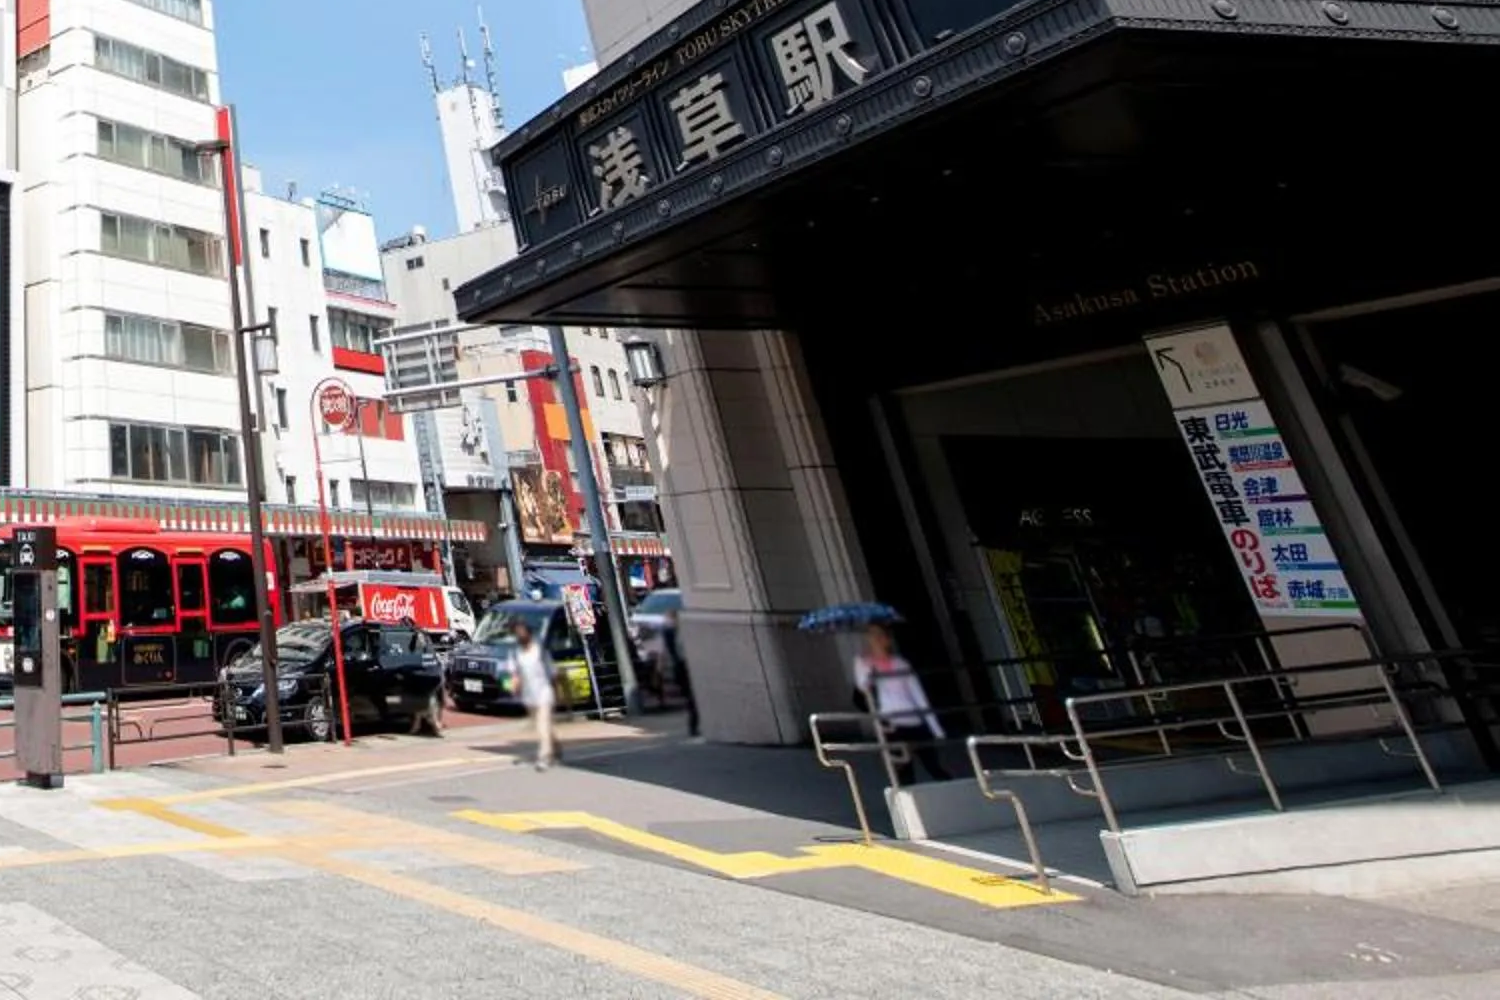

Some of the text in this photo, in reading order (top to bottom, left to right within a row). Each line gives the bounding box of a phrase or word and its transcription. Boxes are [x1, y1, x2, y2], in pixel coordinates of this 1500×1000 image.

[676, 28, 717, 65] TOBU
[589, 0, 870, 216] 浅草駅
[1032, 259, 1261, 328] Asakusa Station
[1215, 411, 1249, 431] 日光
[1243, 476, 1279, 497] 会津
[1180, 416, 1281, 599] 東武電車のりば
[1257, 508, 1295, 528] 館林
[1271, 543, 1309, 563] 太田
